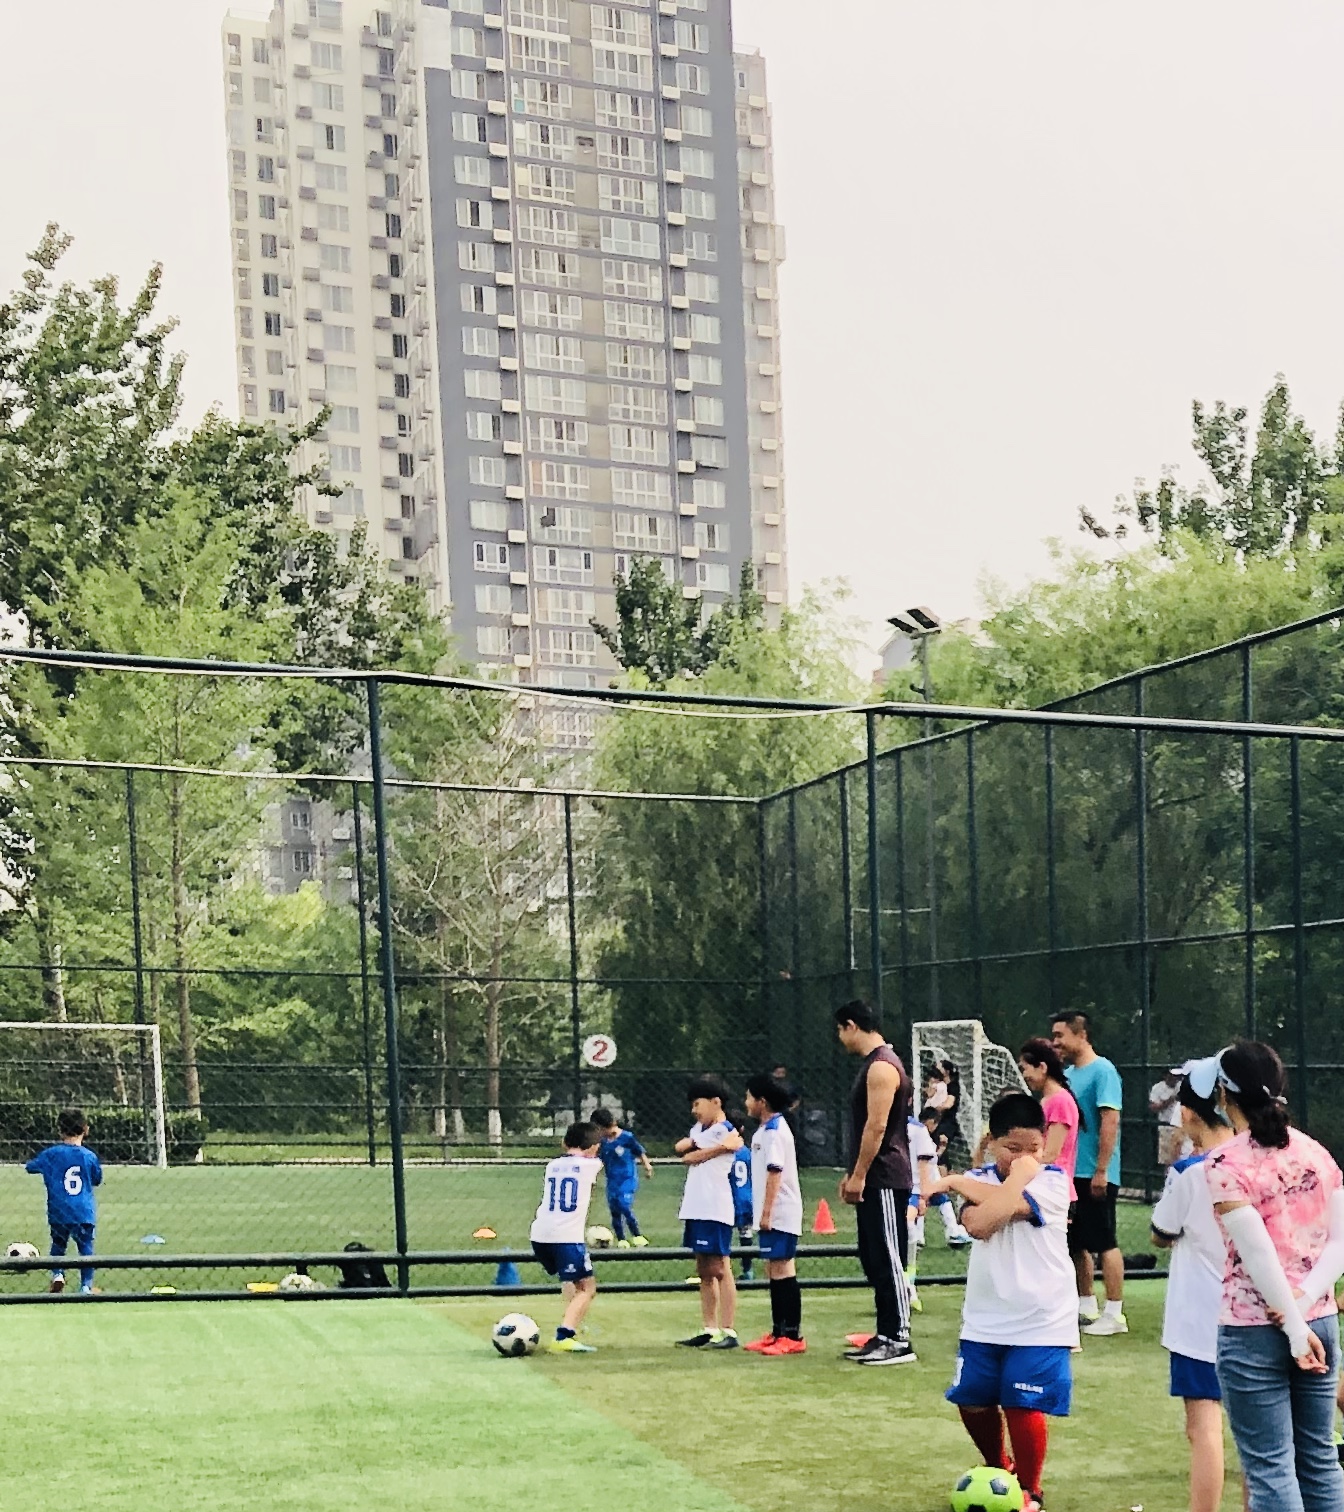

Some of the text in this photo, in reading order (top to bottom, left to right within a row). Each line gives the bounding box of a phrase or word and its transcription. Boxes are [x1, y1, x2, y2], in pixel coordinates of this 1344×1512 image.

[592, 1040, 608, 1062] 2
[64, 1165, 83, 1196] 6
[734, 1161, 748, 1188] 9
[548, 1177, 579, 1213] 10
